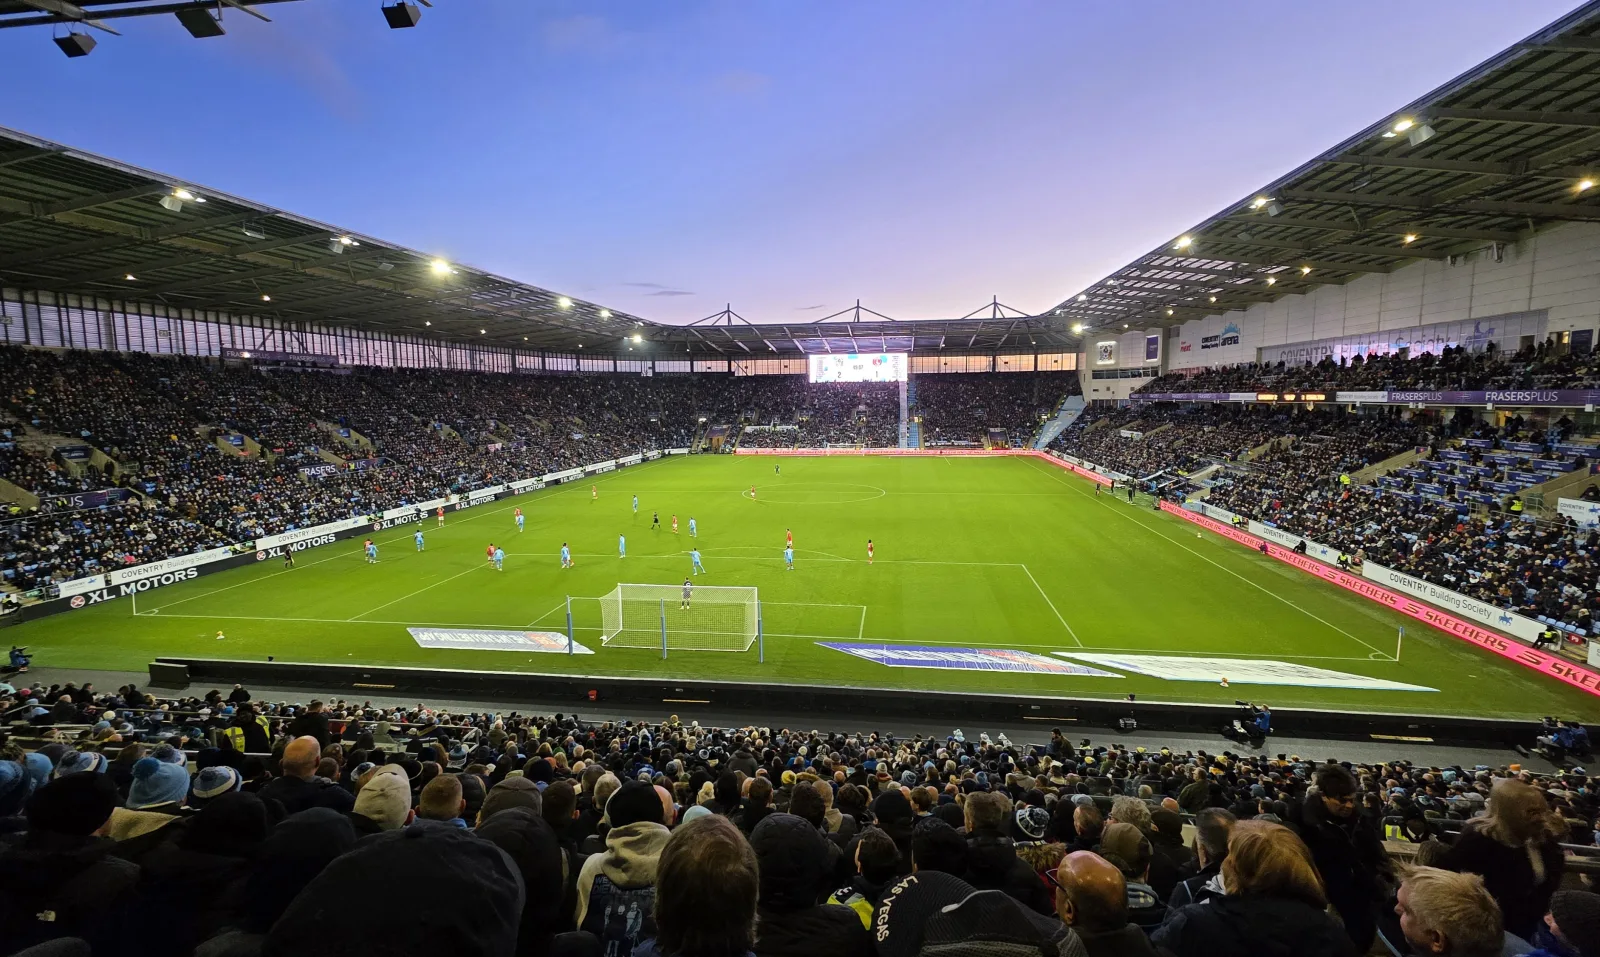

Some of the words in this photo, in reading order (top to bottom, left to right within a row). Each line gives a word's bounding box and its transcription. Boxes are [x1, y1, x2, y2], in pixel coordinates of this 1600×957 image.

[1221, 335, 1239, 346] arena
[1280, 345, 1335, 364] COVENTRY
[837, 371, 842, 379] 2
[1391, 391, 1442, 401] FRASERSPLUS
[1485, 391, 1558, 402] FRASERSPLUS
[525, 482, 546, 492] MOTORS
[460, 501, 469, 509] XL
[470, 494, 495, 506] MOTORS
[1560, 502, 1585, 510] COVENTRY
[381, 520, 394, 530] XL
[394, 511, 429, 526] MOTOS
[278, 530, 310, 543] COVENTRY
[1232, 532, 1262, 549] SKECHER
[1263, 527, 1285, 540] COVENTRY
[268, 546, 286, 558] XL
[288, 533, 336, 552] MOTORS
[121, 563, 164, 579] COVENTRY
[166, 556, 195, 569] Building
[195, 552, 218, 564] Society
[1279, 550, 1320, 573] SKECHERS
[87, 589, 116, 604] XL
[120, 567, 198, 596] MOTORS
[1340, 576, 1398, 605] SKECHERS
[1389, 572, 1428, 594] COVENTRY
[1429, 587, 1461, 608] Building
[1462, 599, 1492, 620] Society
[1423, 610, 1510, 652] SKECHERS
[891, 875, 919, 895] LAS
[876, 895, 897, 942] VEGAS
